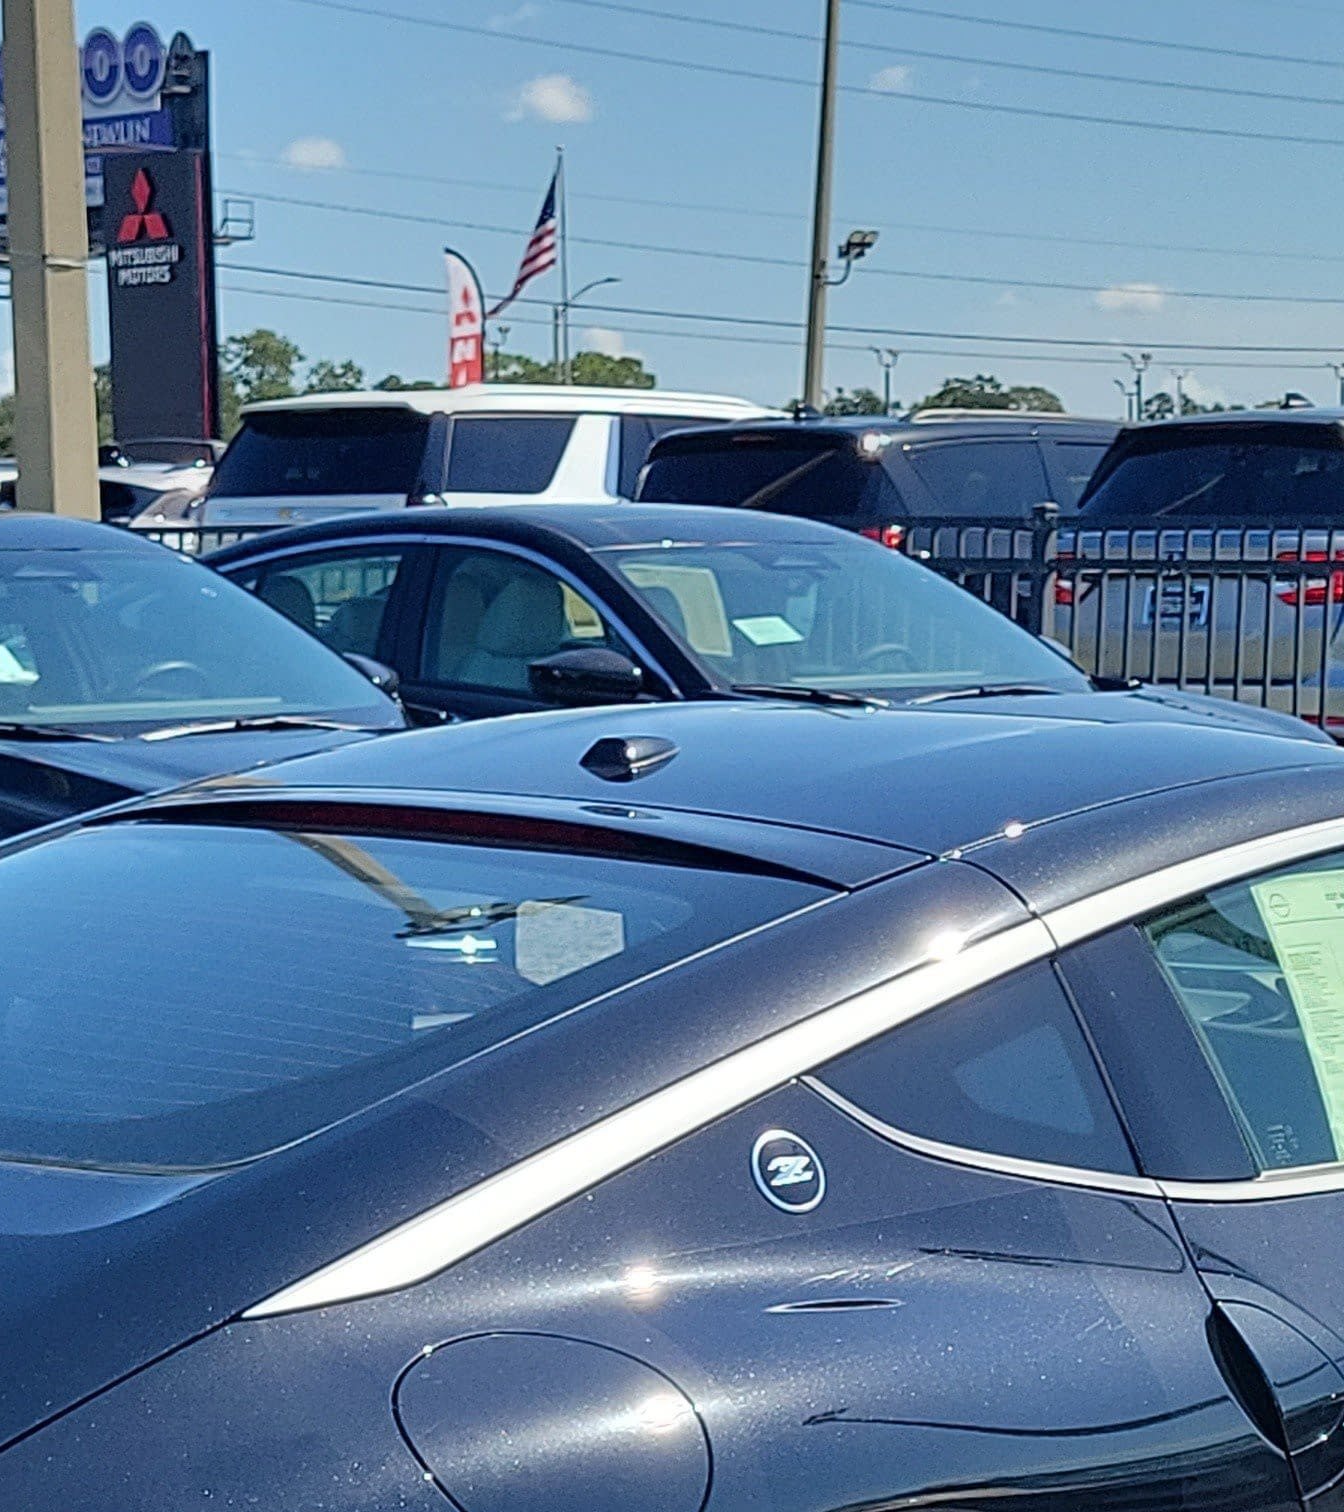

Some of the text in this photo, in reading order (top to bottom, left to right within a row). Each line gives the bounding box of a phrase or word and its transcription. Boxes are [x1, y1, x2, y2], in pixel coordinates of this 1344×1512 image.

[108, 245, 179, 267] MITSUBISHI
[118, 264, 171, 286] MOTORS
[766, 1155, 814, 1187] Z
